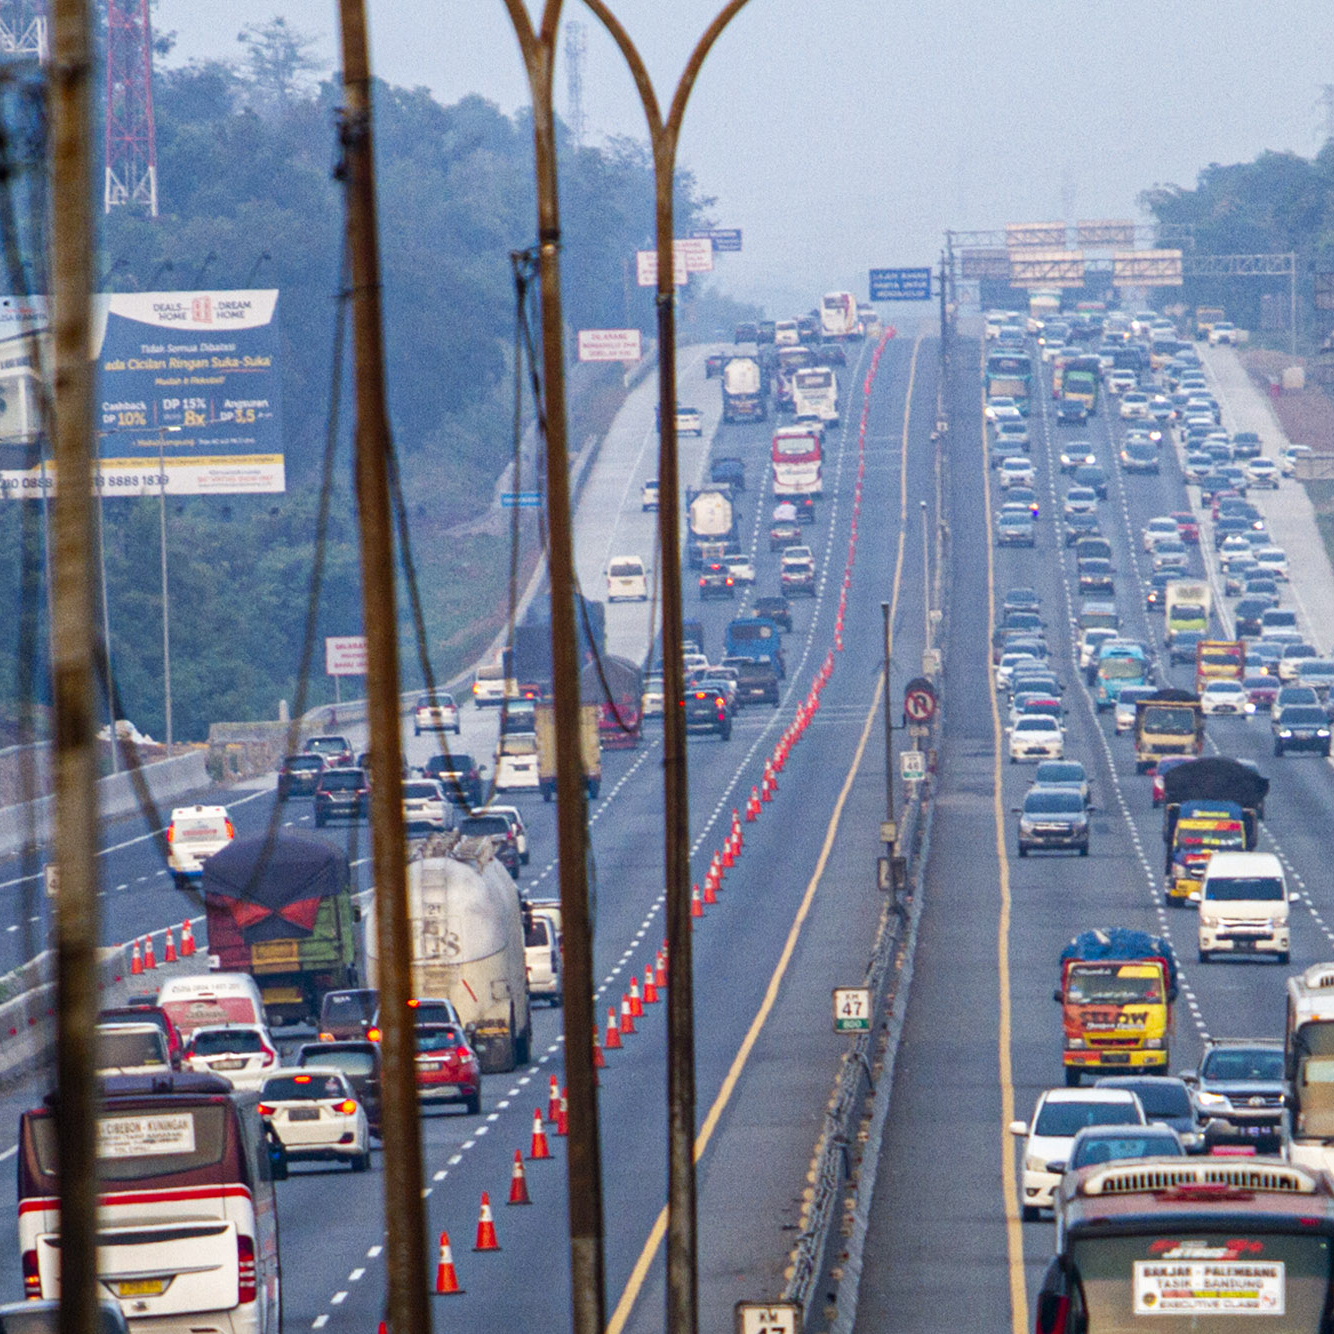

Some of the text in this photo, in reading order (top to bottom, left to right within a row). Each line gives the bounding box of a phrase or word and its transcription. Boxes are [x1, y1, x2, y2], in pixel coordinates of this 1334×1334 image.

[163, 398, 207, 409] DP 15%
[103, 412, 147, 426] DP 10%
[220, 412, 233, 421] DP
[842, 1001, 862, 1015] 47
[1143, 1266, 1277, 1278] BANJAR PALEMBANG
[1157, 1279, 1264, 1289] TASIK BANDUNG
[759, 1312, 778, 1324] KM
